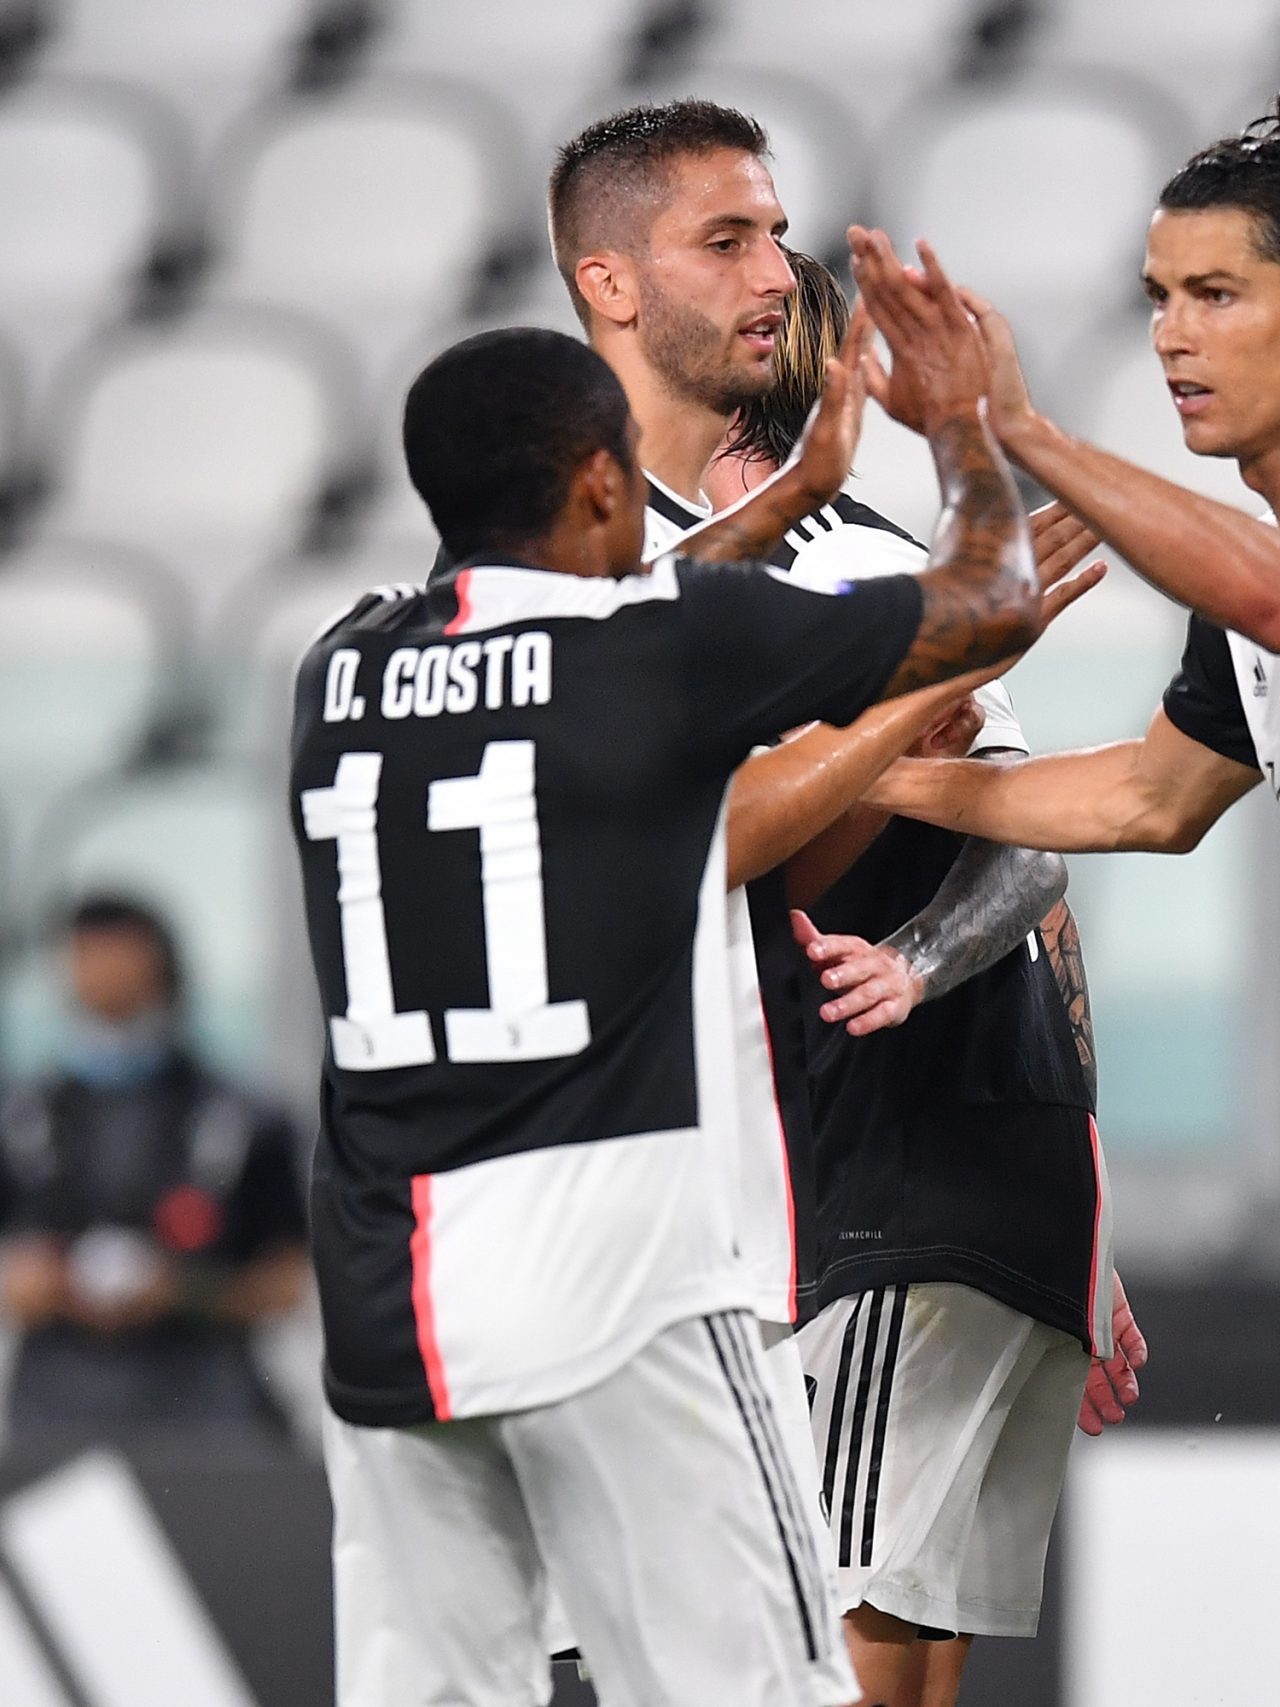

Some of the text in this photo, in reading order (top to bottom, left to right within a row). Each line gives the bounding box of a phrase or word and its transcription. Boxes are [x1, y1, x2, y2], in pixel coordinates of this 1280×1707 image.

[323, 630, 552, 723] D. COSTA
[301, 740, 592, 1072] 11
[838, 1230, 883, 1240] LIMACHILL
